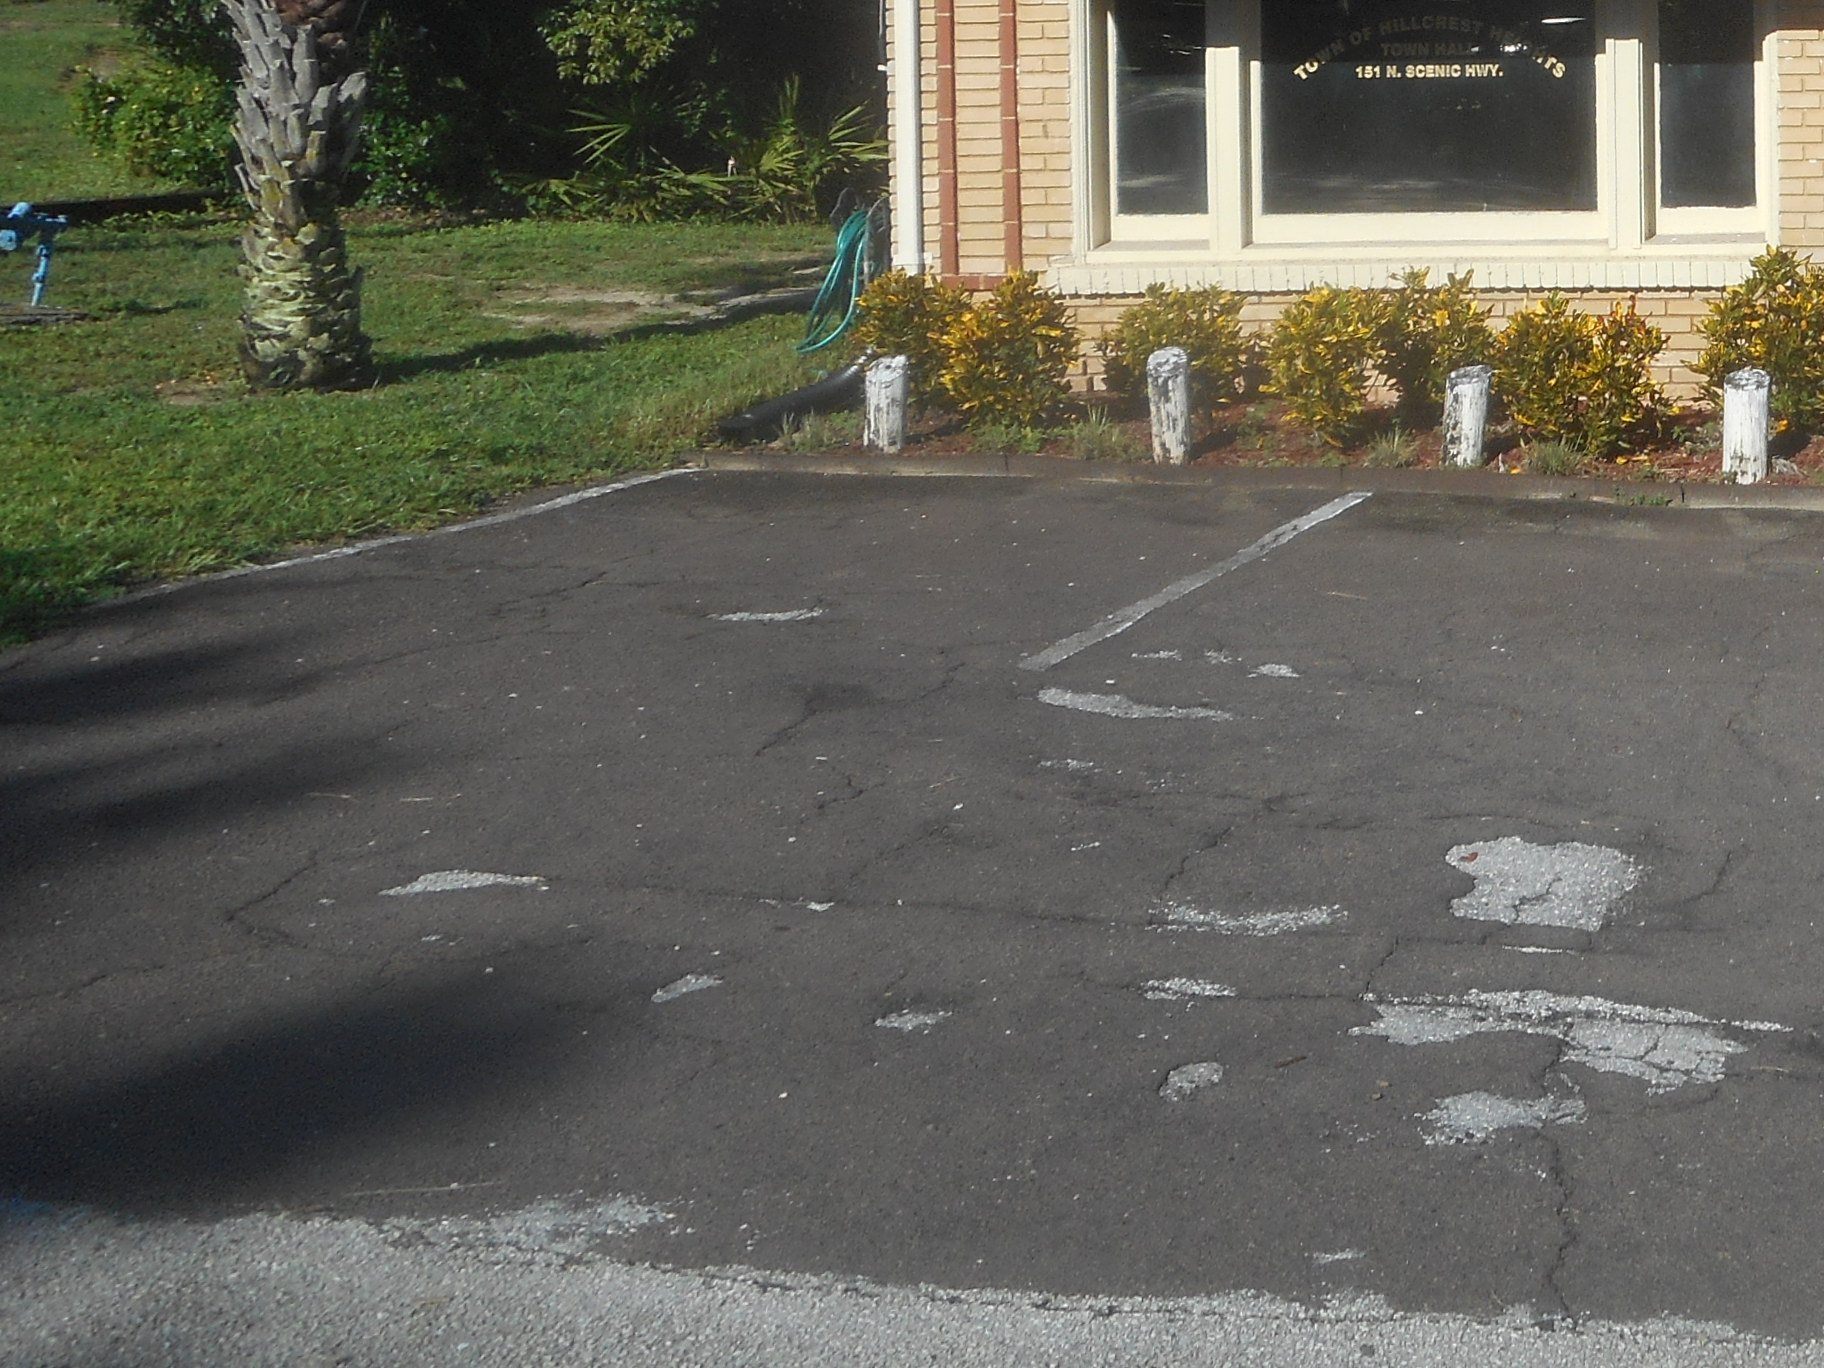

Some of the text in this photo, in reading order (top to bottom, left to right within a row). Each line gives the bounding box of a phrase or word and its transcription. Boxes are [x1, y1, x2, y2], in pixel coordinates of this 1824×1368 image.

[1293, 38, 1345, 80] TOWN
[1348, 26, 1373, 46] OF
[1379, 16, 1484, 36] HILLCREST
[1380, 41, 1430, 57] TOWN
[1354, 64, 1505, 79] 151 N. SCENIC HWY.
